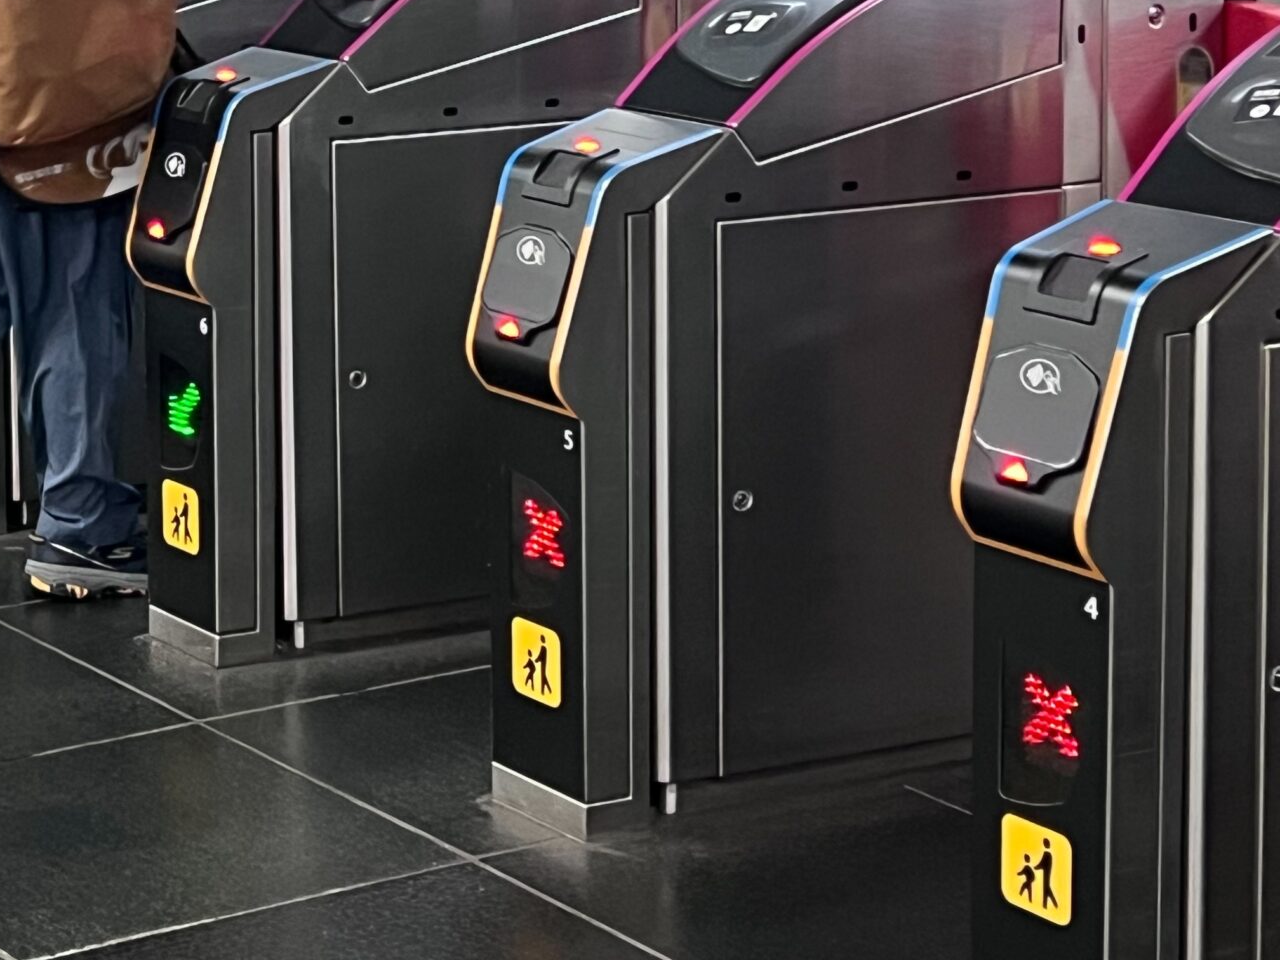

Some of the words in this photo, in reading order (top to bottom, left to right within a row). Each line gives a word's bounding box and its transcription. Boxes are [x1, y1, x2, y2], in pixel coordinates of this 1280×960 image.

[199, 317, 209, 335] 6
[563, 429, 574, 450] 5
[1083, 596, 1099, 620] 4
